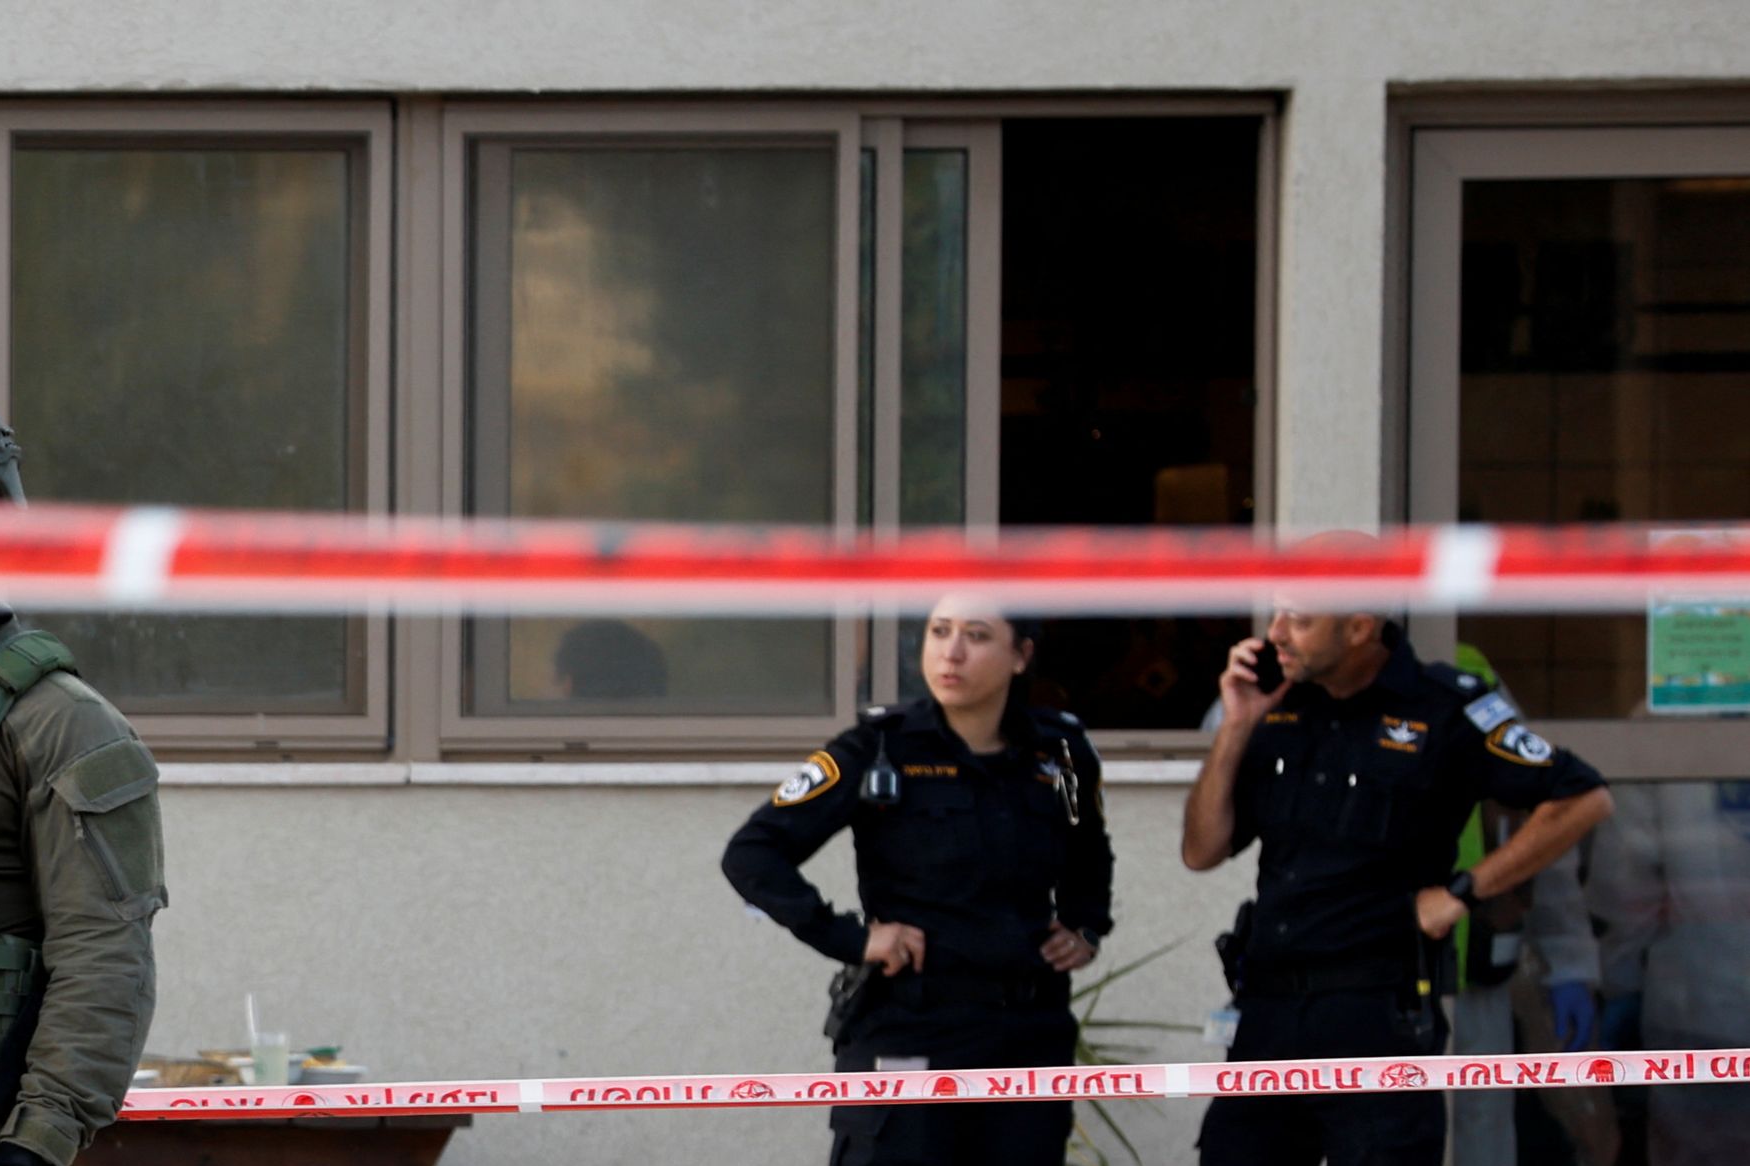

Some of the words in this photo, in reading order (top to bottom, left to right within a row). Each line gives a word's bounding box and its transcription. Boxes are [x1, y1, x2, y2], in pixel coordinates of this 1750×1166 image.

[987, 1070, 1036, 1095] אין
[1052, 1071, 1155, 1095] מעבר
[1217, 1067, 1363, 1092] משטרת
[1447, 1062, 1567, 1087] ישראל
[1644, 1053, 1695, 1080] אין
